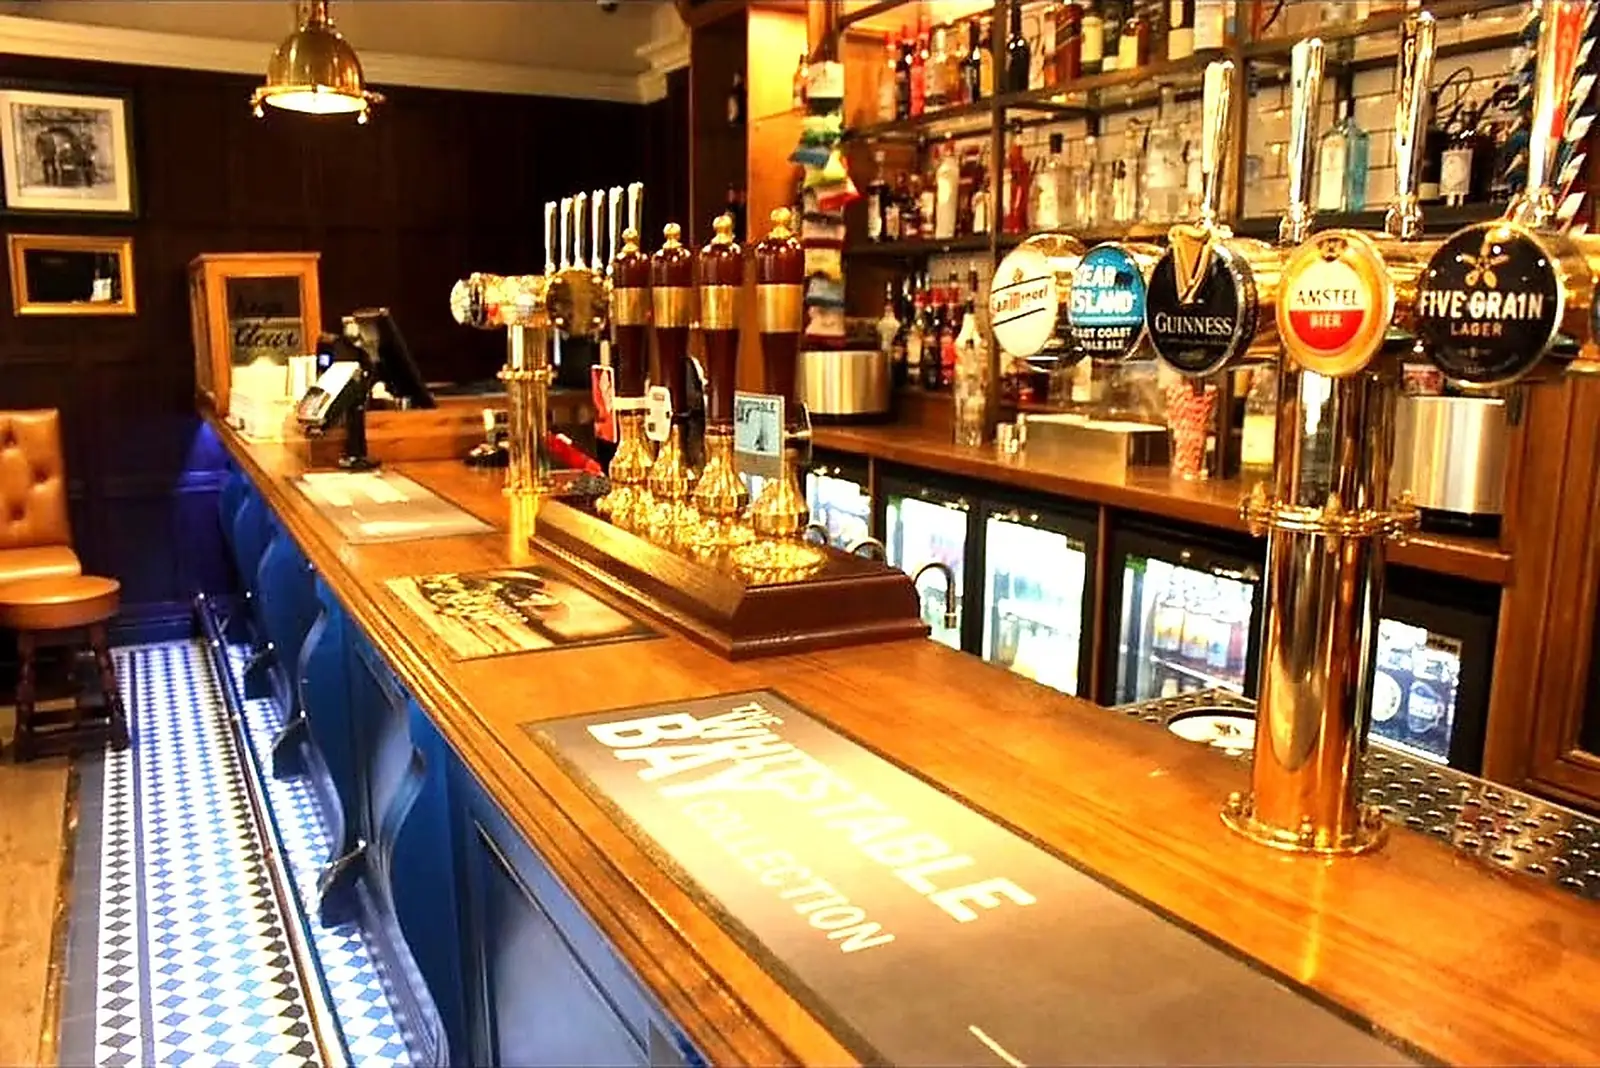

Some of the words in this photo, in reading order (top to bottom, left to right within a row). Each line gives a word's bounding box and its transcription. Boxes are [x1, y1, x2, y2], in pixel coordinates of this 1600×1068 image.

[1297, 288, 1359, 306] AMSTEL
[1420, 290, 1466, 318] FIVE
[1097, 327, 1132, 339] COAST
[1155, 311, 1232, 336] GUINNESS
[1310, 313, 1342, 328] BIER
[1450, 322, 1503, 337] LAGER
[587, 712, 770, 798] BAY
[698, 705, 1038, 922] WHITSTABLE
[681, 800, 895, 954] COLLECTION
